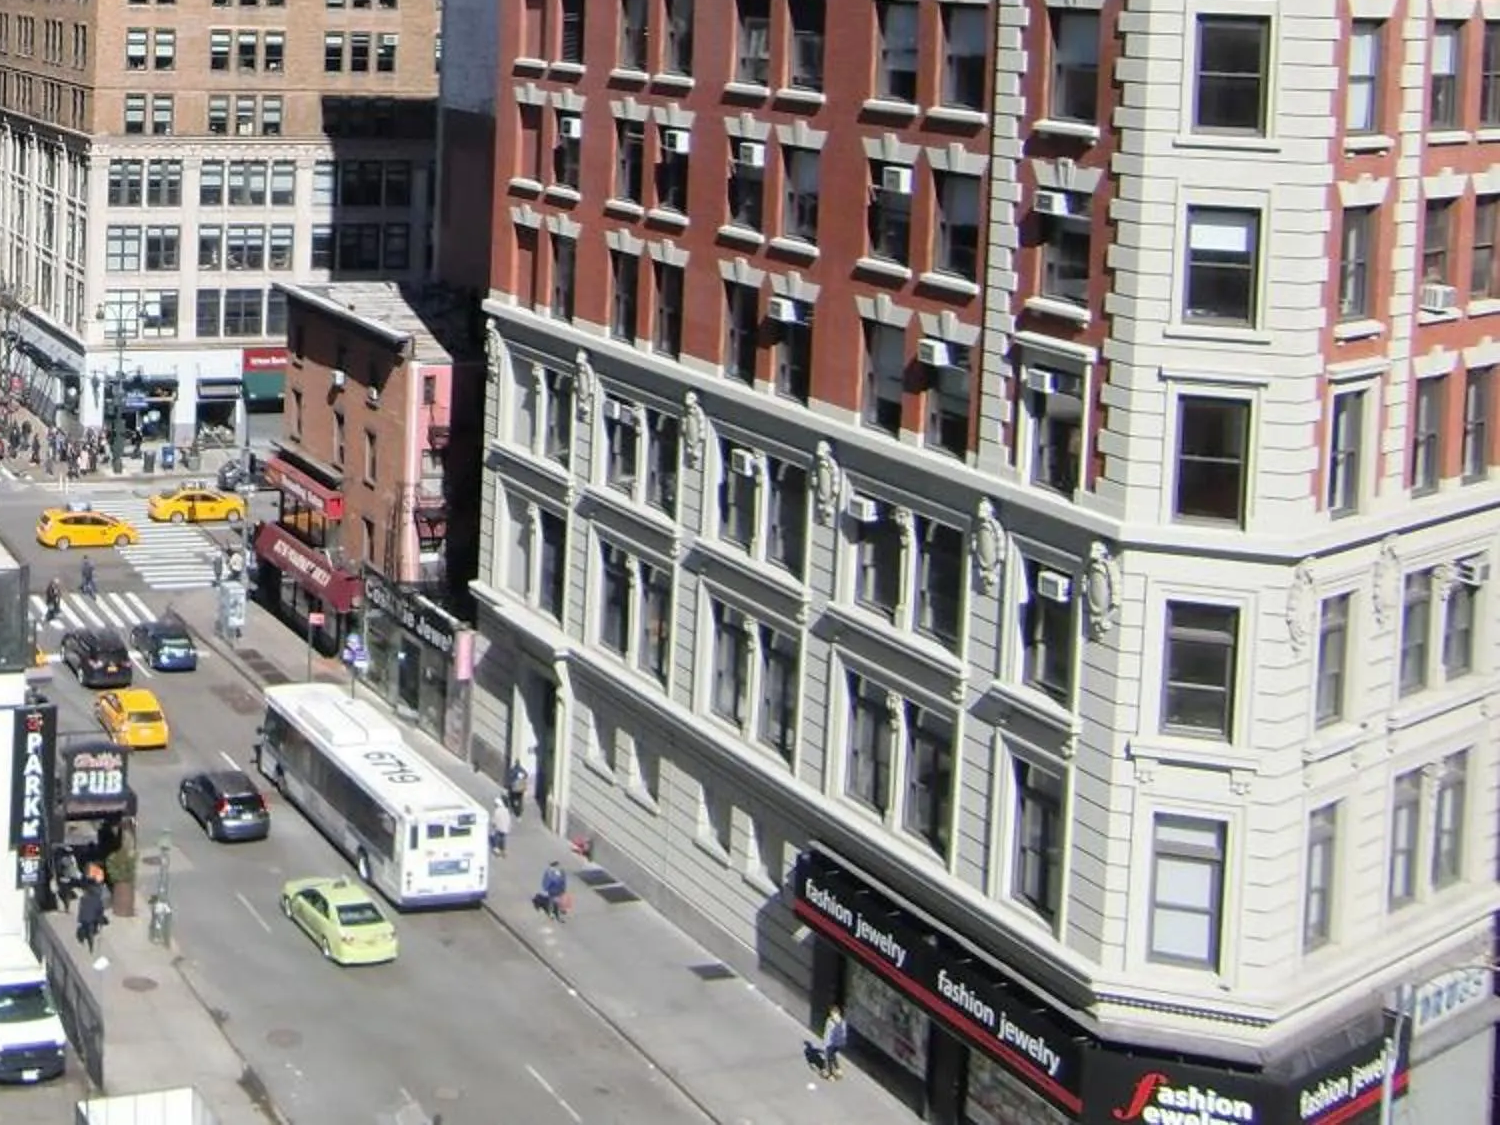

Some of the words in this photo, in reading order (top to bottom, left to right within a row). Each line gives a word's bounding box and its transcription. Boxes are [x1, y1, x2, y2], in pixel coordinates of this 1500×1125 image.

[23, 732, 43, 817] PARK
[71, 769, 124, 796] PUB
[364, 751, 422, 784] 6719
[805, 879, 852, 927] fashion
[855, 913, 907, 967] jewelry
[937, 969, 995, 1027] fashion
[997, 1012, 1060, 1075] jewelry
[1300, 1077, 1349, 1120] fashion
[1350, 1037, 1397, 1099] jewel
